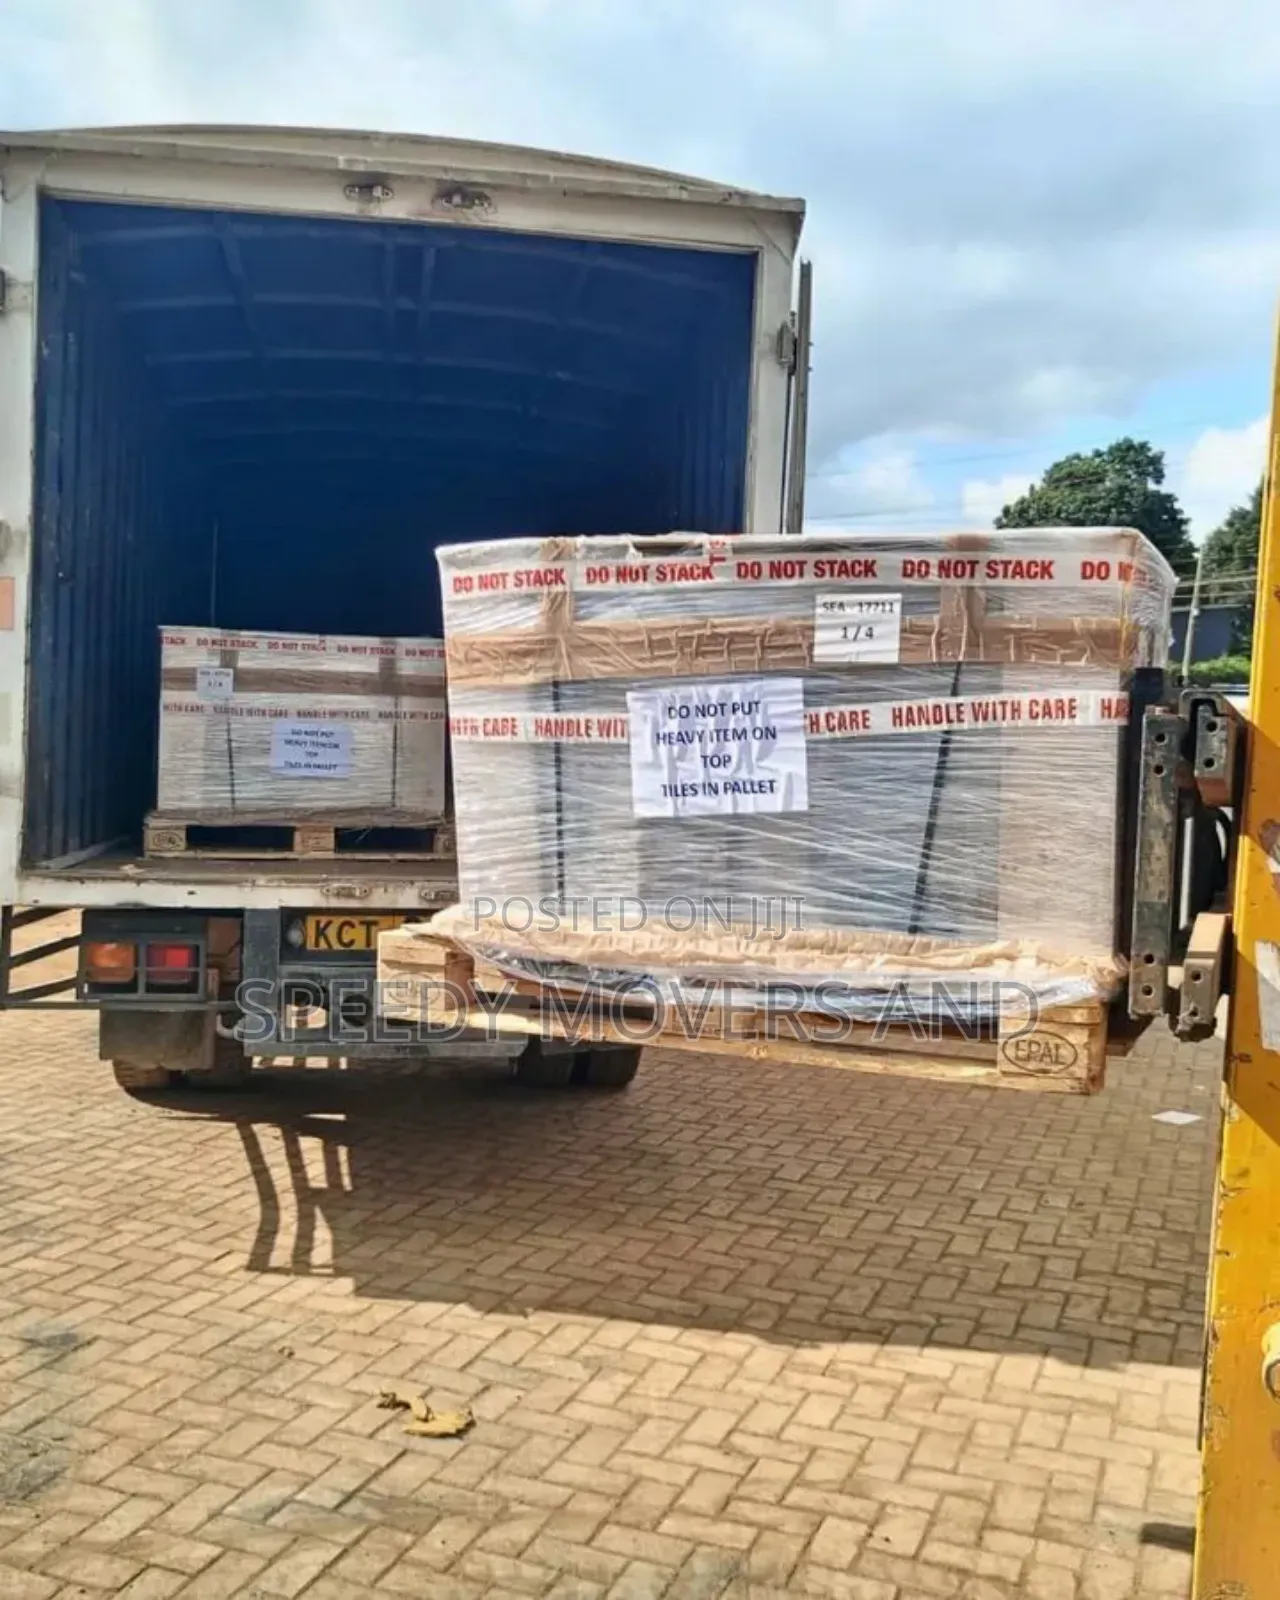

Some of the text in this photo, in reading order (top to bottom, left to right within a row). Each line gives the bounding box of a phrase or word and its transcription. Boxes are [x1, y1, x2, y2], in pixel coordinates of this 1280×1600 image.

[586, 563, 714, 584] DO NOT STACK
[736, 559, 878, 579] DO NOT STACK
[902, 559, 1055, 579] DO NOT STACK
[1080, 560, 1110, 581] DO
[453, 567, 565, 593] DO NOT STACK
[668, 701, 761, 720] DO NOT PUT
[825, 709, 870, 732] CARE
[892, 702, 965, 727] HANDLE
[971, 700, 1021, 722] WITH
[1028, 698, 1077, 720] CARE
[482, 718, 518, 737] CARE
[535, 718, 628, 738] HANDLE WIT
[656, 726, 777, 746] HEAVY ITEM ON
[700, 755, 732, 769] TOP
[661, 780, 776, 798] TILES IN PALLET
[313, 918, 379, 949] KCT
[1014, 1039, 1068, 1066] EPAL
